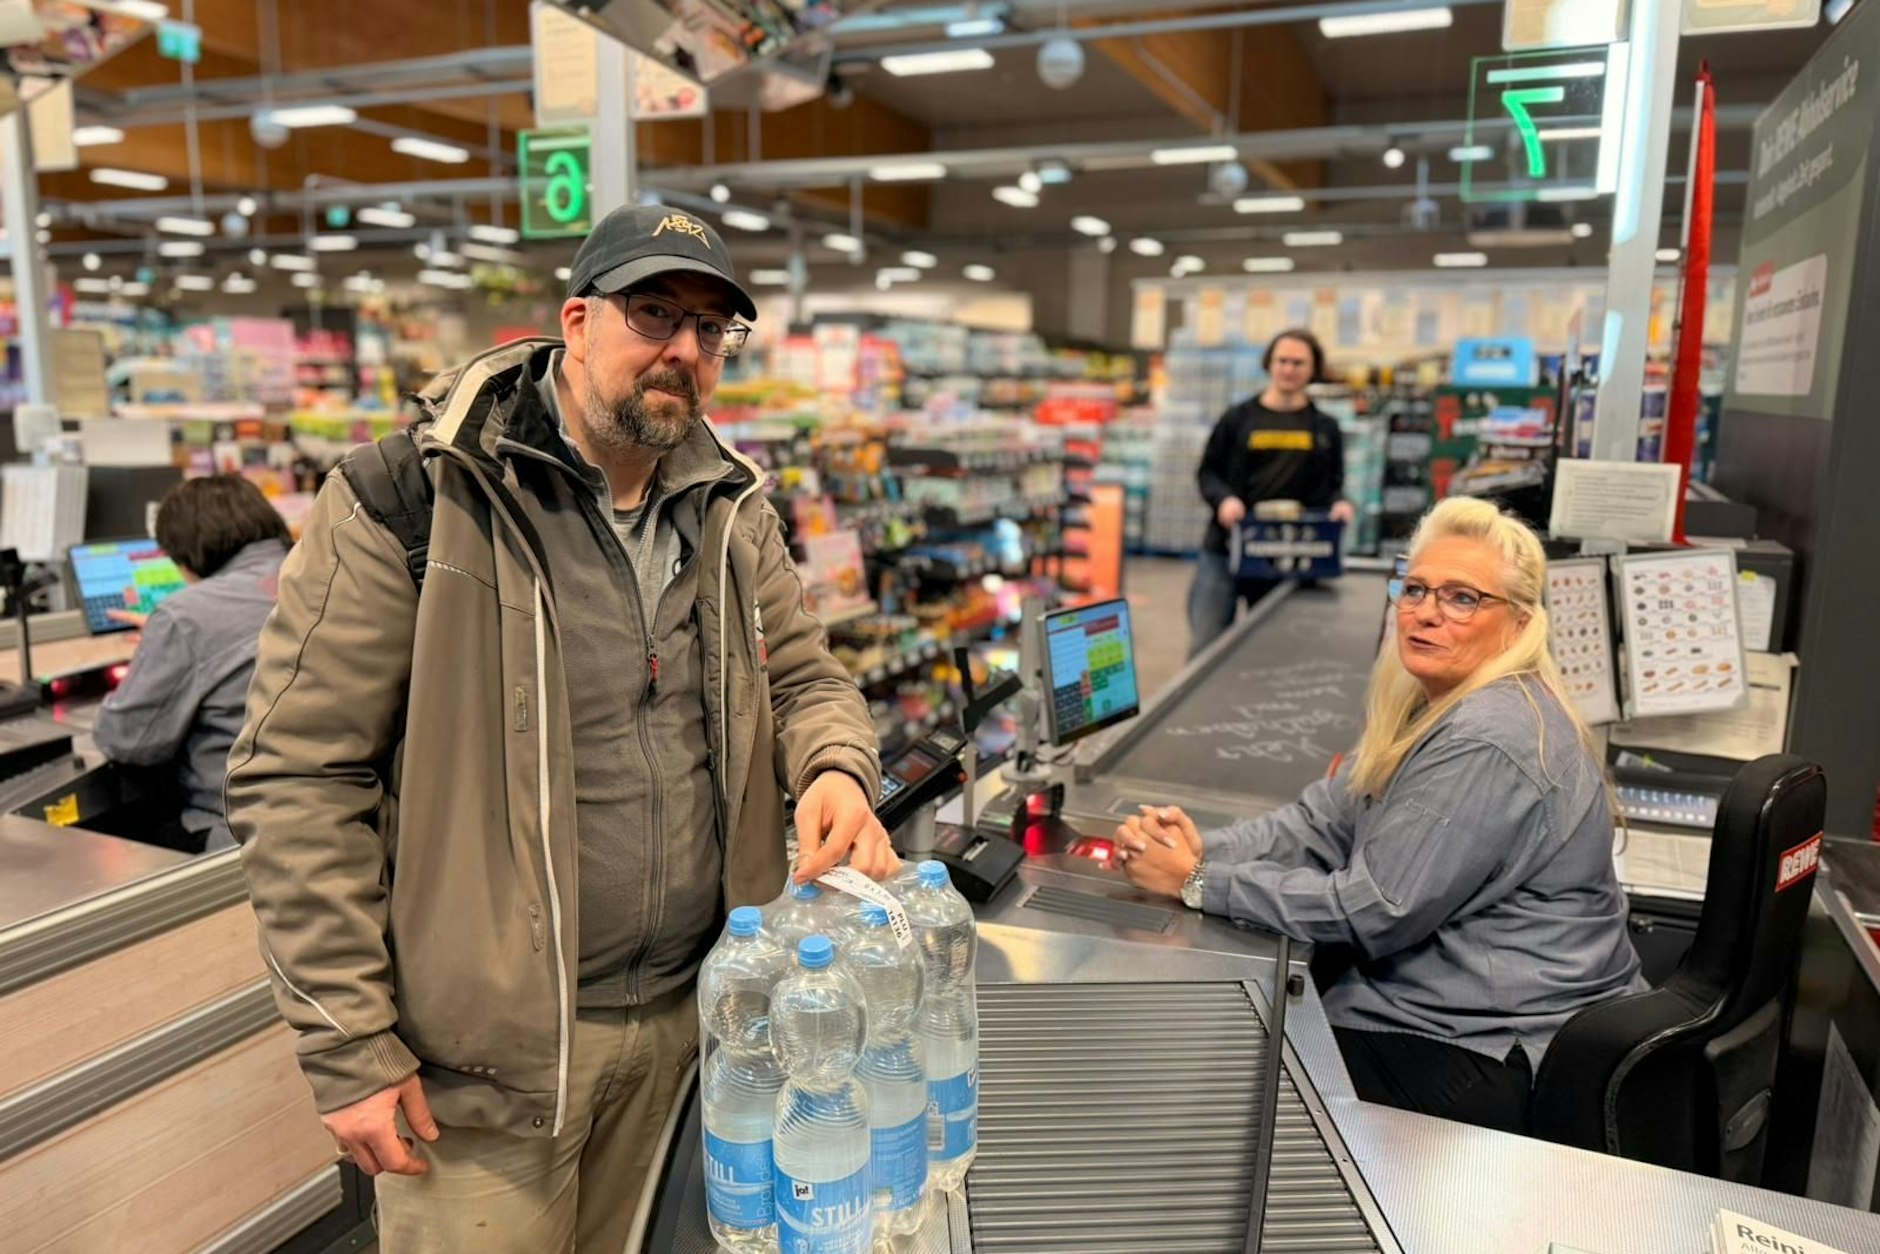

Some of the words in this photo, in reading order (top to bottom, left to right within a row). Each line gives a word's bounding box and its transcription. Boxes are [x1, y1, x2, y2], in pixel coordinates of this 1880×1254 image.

[1779, 838, 1820, 884] REWE
[888, 910, 901, 938] 14136
[898, 912, 908, 931] PLU
[705, 1155, 734, 1184] TILL
[795, 1185, 809, 1197] ja!
[811, 1196, 866, 1227] STILL
